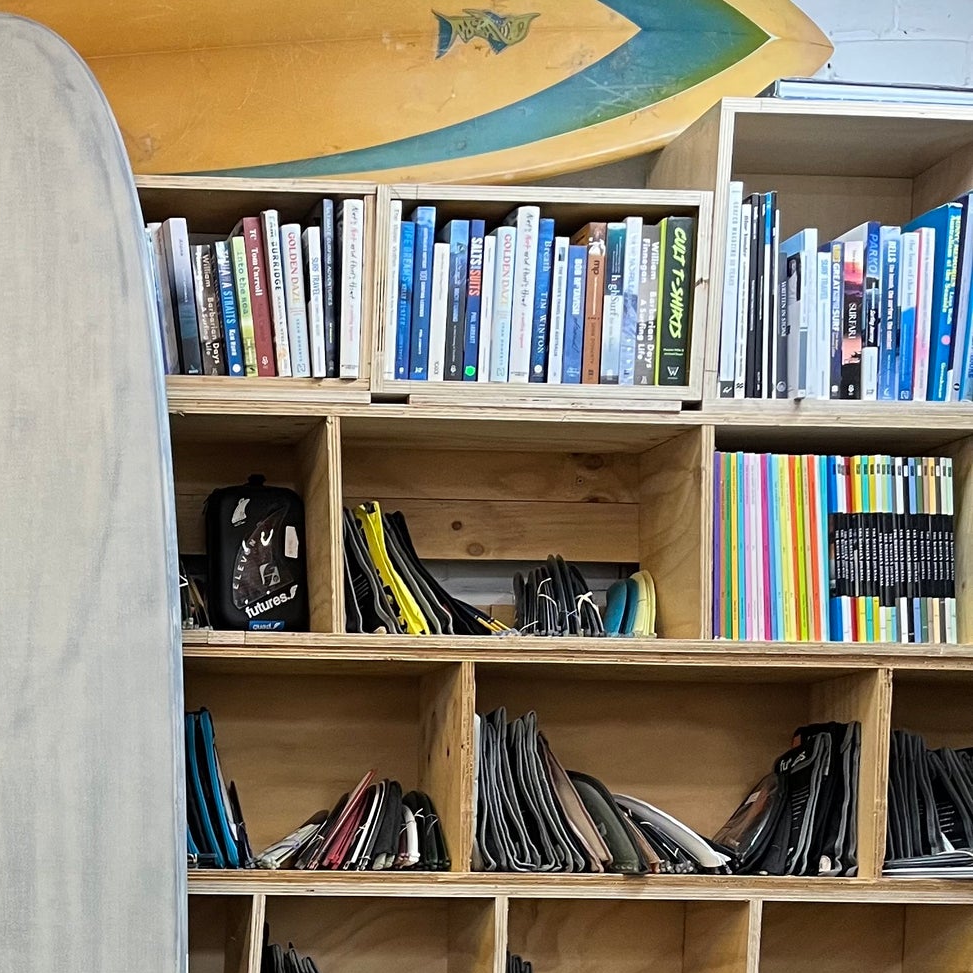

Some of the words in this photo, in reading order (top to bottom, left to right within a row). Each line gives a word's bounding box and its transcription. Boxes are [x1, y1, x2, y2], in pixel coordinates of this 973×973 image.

[249, 228, 257, 241] TC
[403, 225, 413, 244] PIPE
[672, 226, 687, 267] CULT
[236, 251, 245, 274] into
[251, 247, 259, 266] Tom
[287, 232, 298, 275] GOLDEN
[311, 257, 320, 272] SURF
[401, 246, 412, 282] DREAMS
[470, 236, 483, 266] SALTS
[502, 233, 512, 278] GOLDEN
[542, 240, 552, 272] Breath
[640, 238, 651, 284] Finnegan
[650, 241, 660, 280] William
[868, 233, 879, 274] PARKO
[887, 240, 897, 263] BELLS
[202, 254, 211, 288] William
[271, 241, 282, 291] BURRIDGE
[573, 257, 583, 275] BOB
[591, 260, 601, 276] mp
[237, 277, 247, 296] the
[252, 266, 263, 296] Carroll
[290, 277, 300, 304] DAZE
[312, 275, 321, 296] TRAVEL
[468, 270, 481, 296] SUITS
[500, 279, 510, 306] DAZE
[222, 290, 236, 324] STRAITS
[540, 291, 548, 309] TIM
[605, 274, 622, 317] hghSurf
[668, 268, 684, 339] T-SHIRTS
[780, 281, 788, 309] WRITTEN
[207, 297, 218, 340] Barbarian
[399, 300, 407, 325] SLATER
[636, 308, 647, 341] Surfing
[647, 291, 657, 341] Barbarian
[832, 309, 840, 332] SURF
[848, 303, 857, 339] SURFARI
[201, 314, 210, 340] Surfing
[537, 314, 547, 354] WINTON
[204, 341, 212, 356] Life
[212, 342, 221, 364] Days
[637, 343, 646, 360] Life
[645, 343, 655, 369] Days
